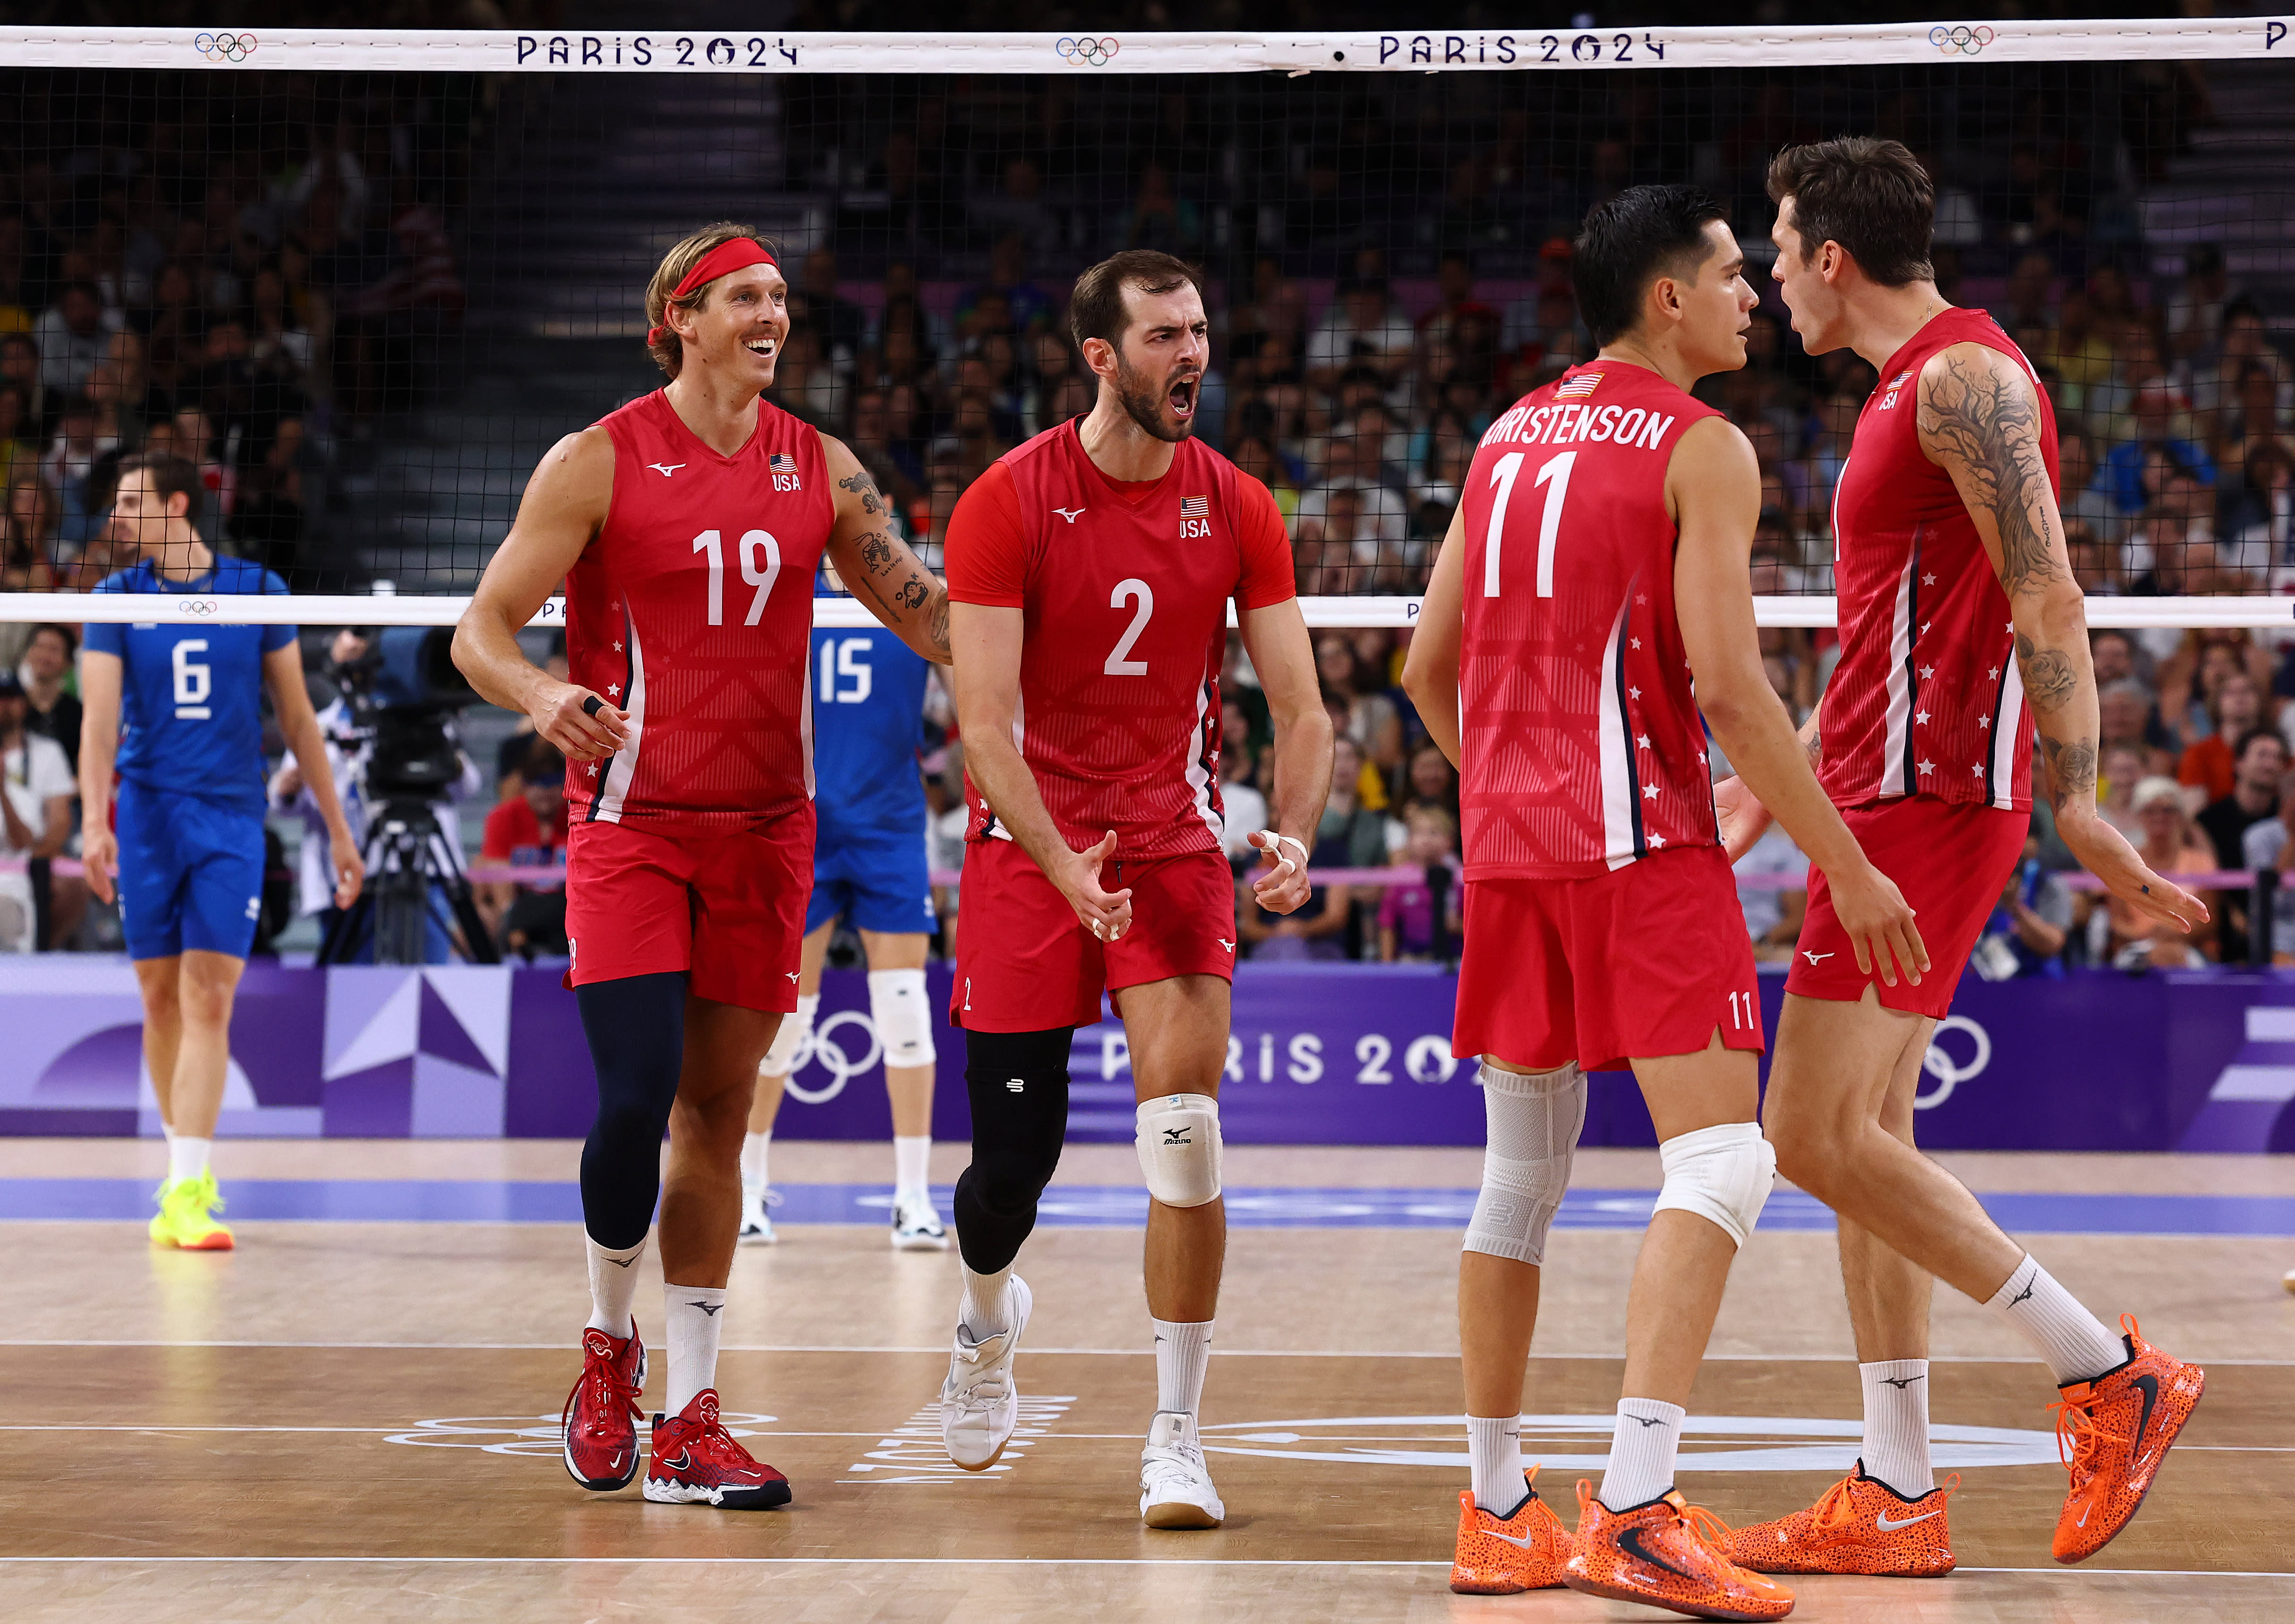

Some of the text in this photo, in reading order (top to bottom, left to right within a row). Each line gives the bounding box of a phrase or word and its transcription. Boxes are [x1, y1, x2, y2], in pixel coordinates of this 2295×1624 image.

[676, 37, 798, 67] 2024
[1541, 33, 1665, 62] 2024
[1879, 390, 1898, 411] USA
[1480, 404, 1675, 450] CHRISTENSON
[772, 473, 801, 491] USA
[1179, 518, 1211, 539] USA
[1484, 450, 1578, 598] 11
[692, 530, 781, 625] 19
[1104, 578, 1153, 676] 2
[171, 639, 211, 704] 6
[820, 638, 873, 704] 15
[964, 976, 972, 1011] 2
[1729, 991, 1754, 1030] 11
